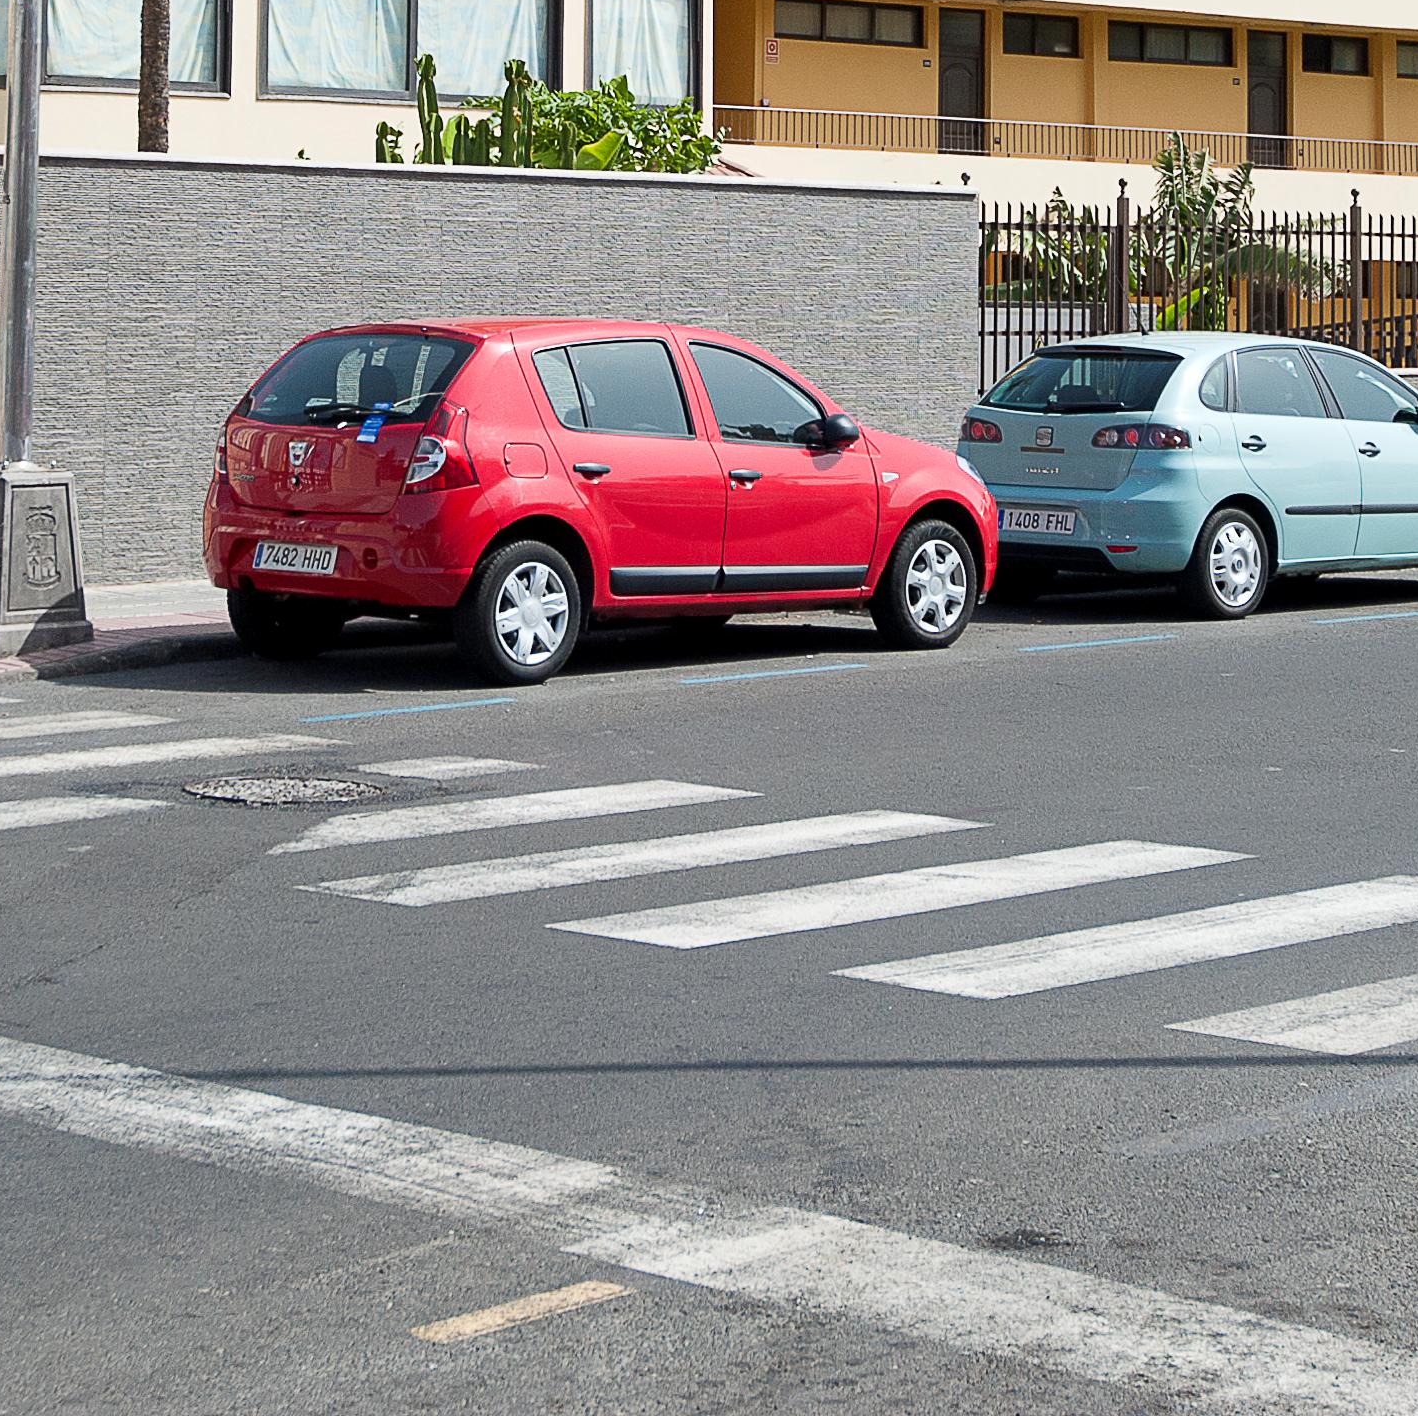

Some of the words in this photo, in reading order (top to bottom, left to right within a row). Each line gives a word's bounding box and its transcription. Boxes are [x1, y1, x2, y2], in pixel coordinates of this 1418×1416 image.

[1007, 511, 1041, 530] 1408
[1045, 513, 1073, 532] FHL
[263, 544, 299, 567] 7482
[301, 548, 333, 571] HHD
